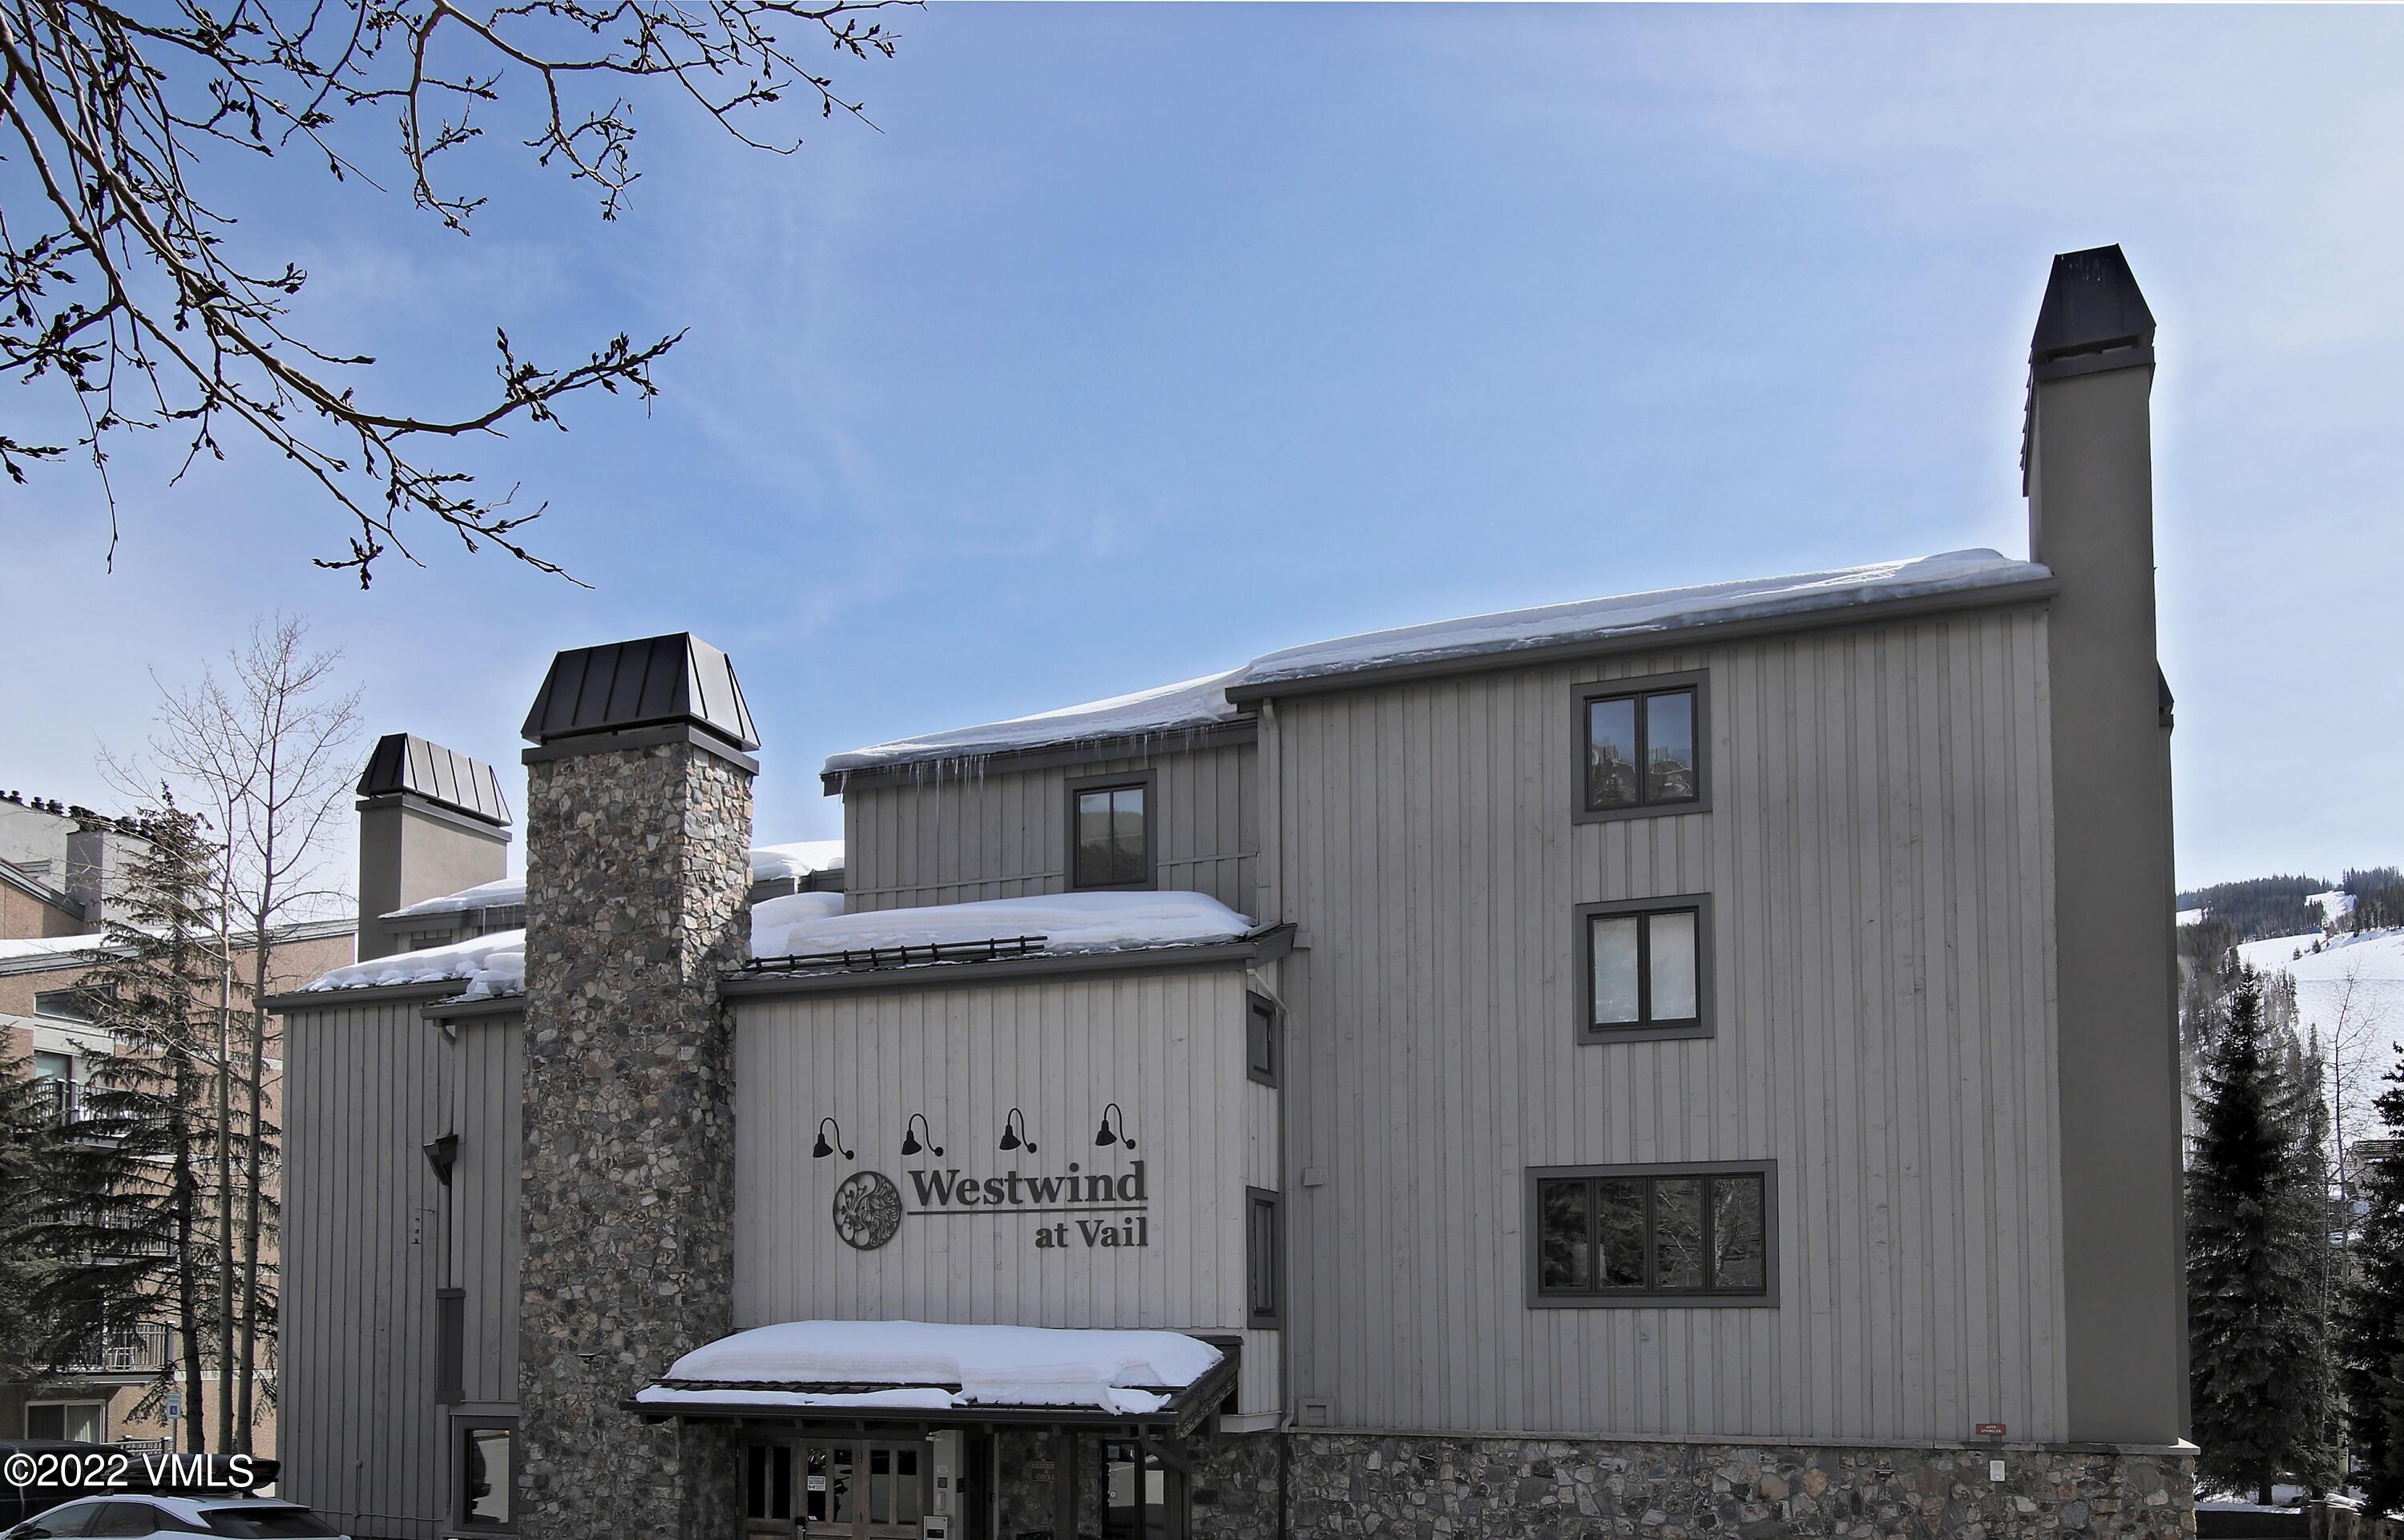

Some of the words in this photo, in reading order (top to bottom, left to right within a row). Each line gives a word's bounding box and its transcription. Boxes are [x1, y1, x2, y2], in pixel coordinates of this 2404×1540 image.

[907, 1160, 1148, 1206] Westwind
[1035, 1223, 1068, 1248] at
[1075, 1216, 1148, 1247] Vail
